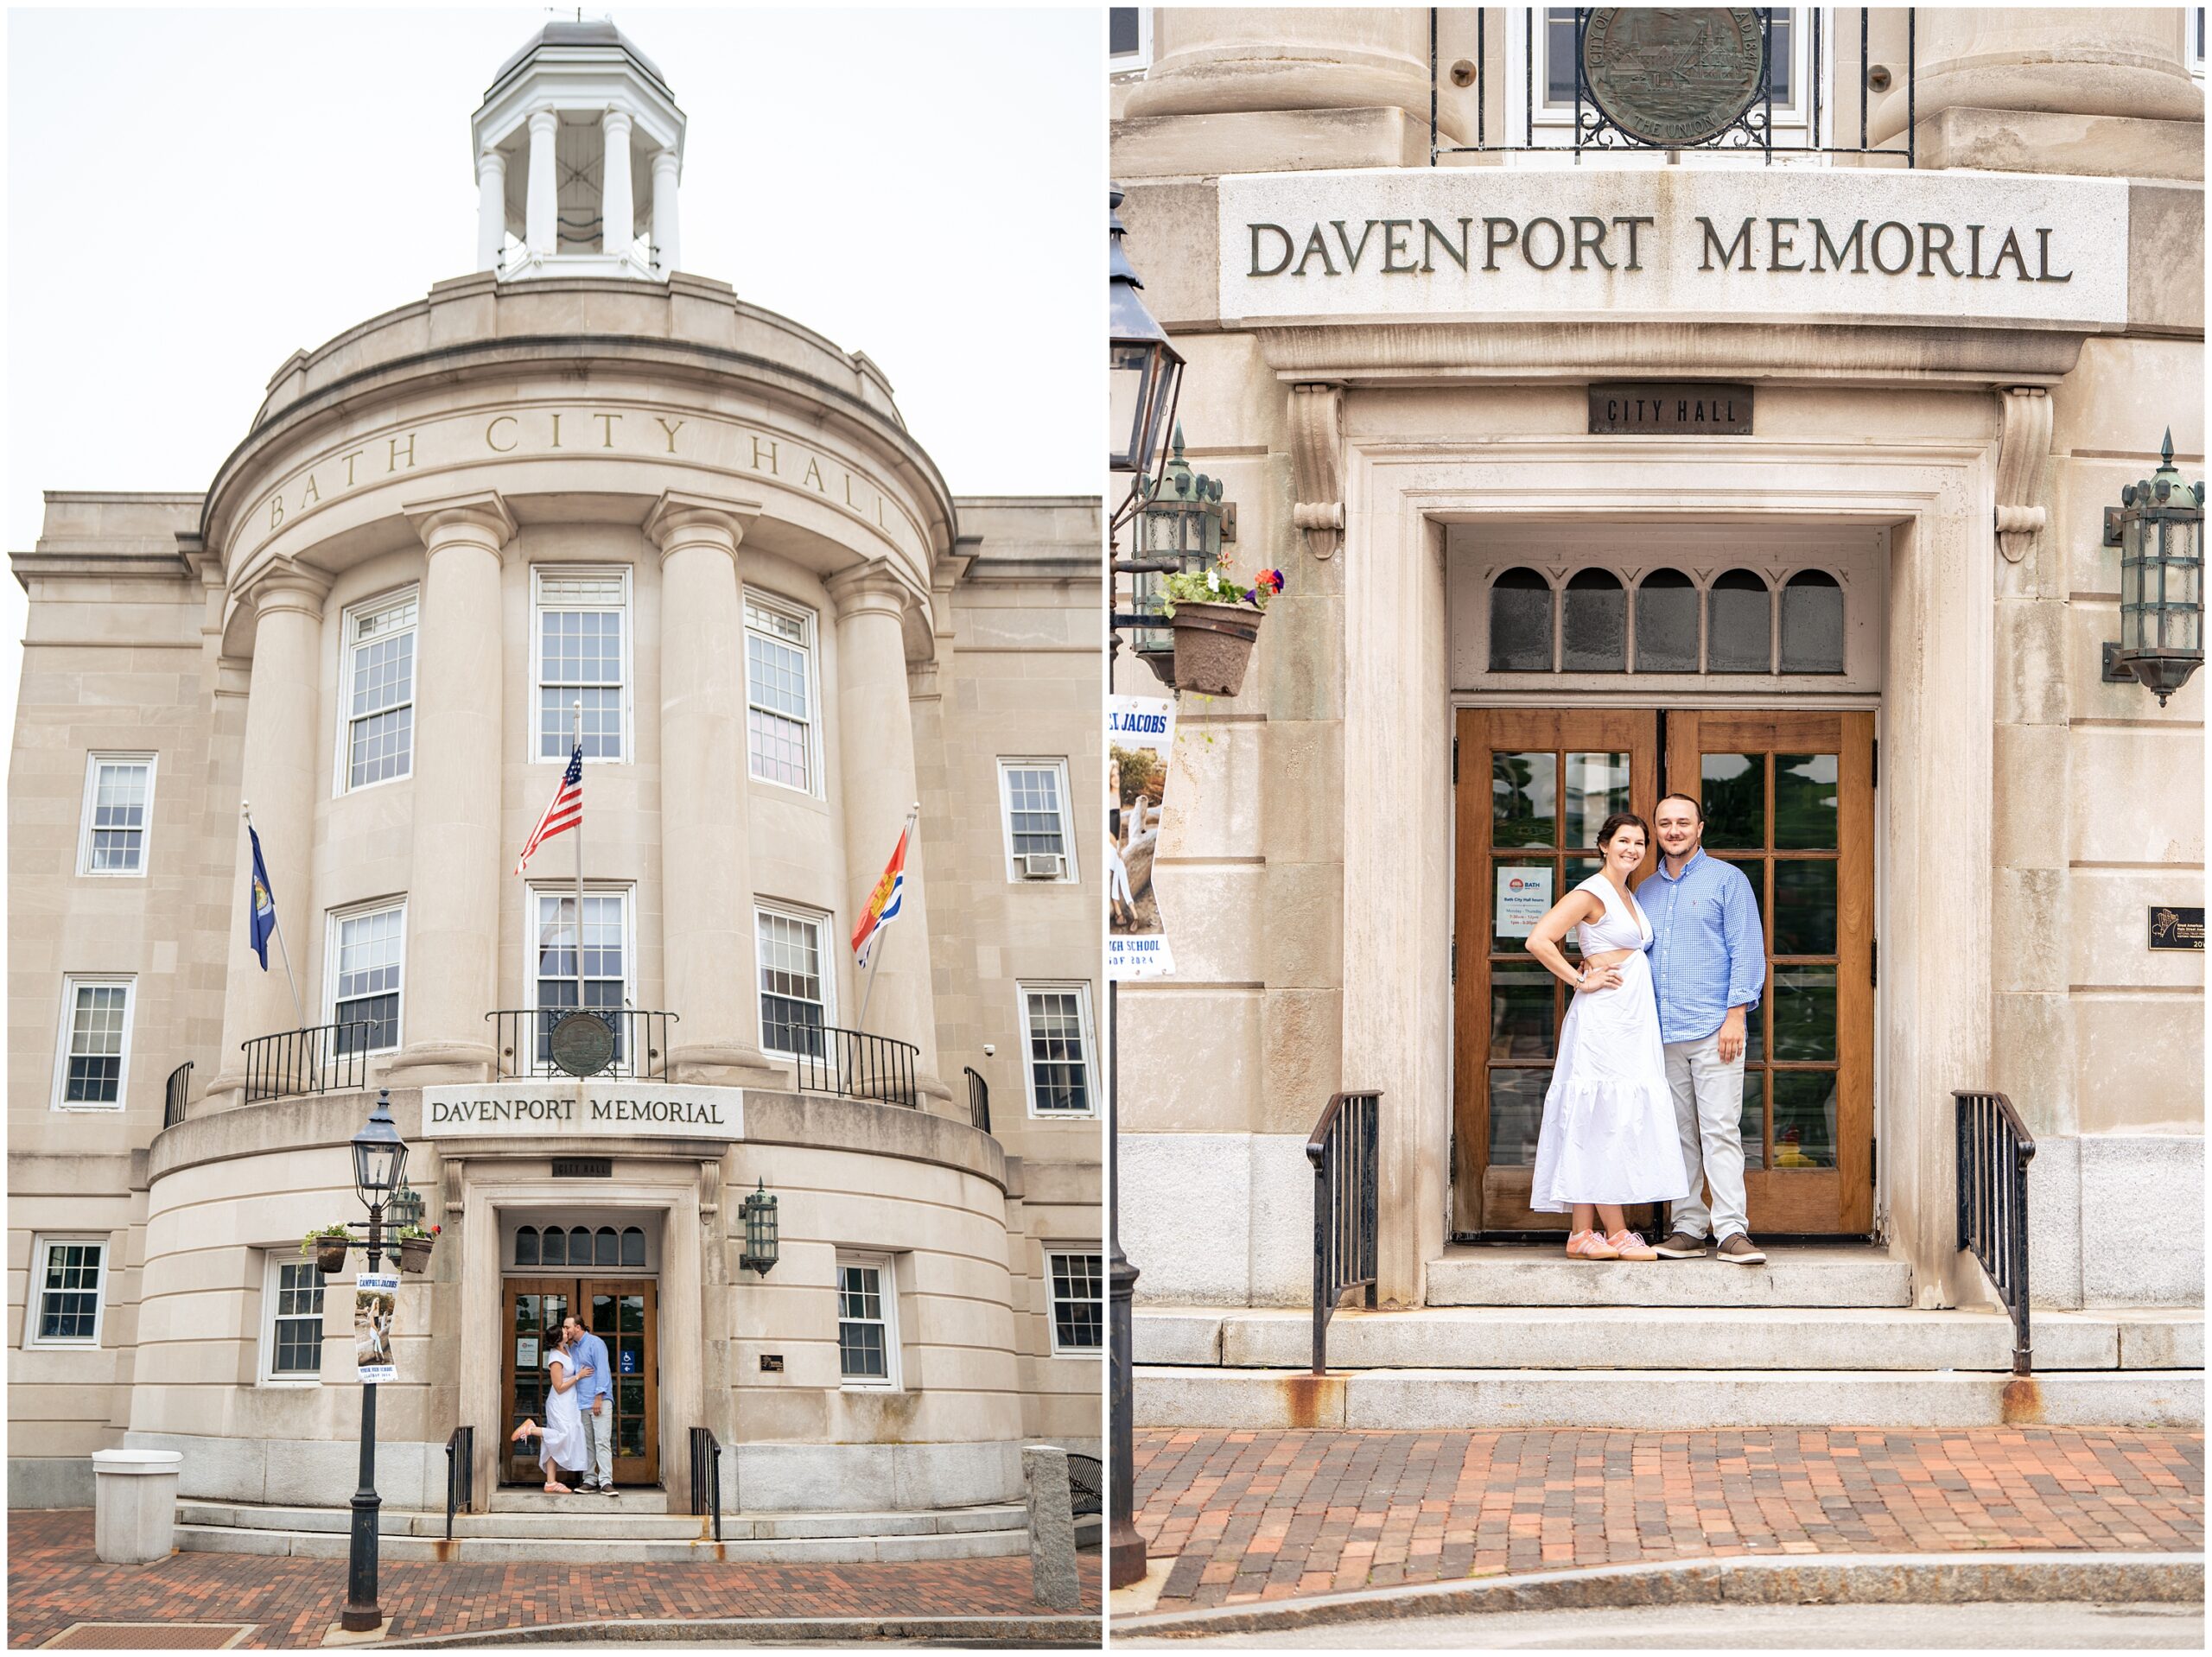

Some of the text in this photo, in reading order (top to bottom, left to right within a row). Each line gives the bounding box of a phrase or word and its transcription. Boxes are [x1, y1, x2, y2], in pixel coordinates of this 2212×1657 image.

[1590, 32, 1605, 63] CITY
[1632, 115, 1716, 137] THE UNION
[1246, 216, 2074, 283] DAVENPORT MEMORIAL
[1607, 399, 1736, 422] CITY HALL
[269, 413, 893, 536] BATH CITY HALL
[1121, 713, 1166, 733] JACOBS
[1127, 940, 1160, 951] SCHOOL
[431, 1100, 725, 1124] DAVENPORT MEMORIAL
